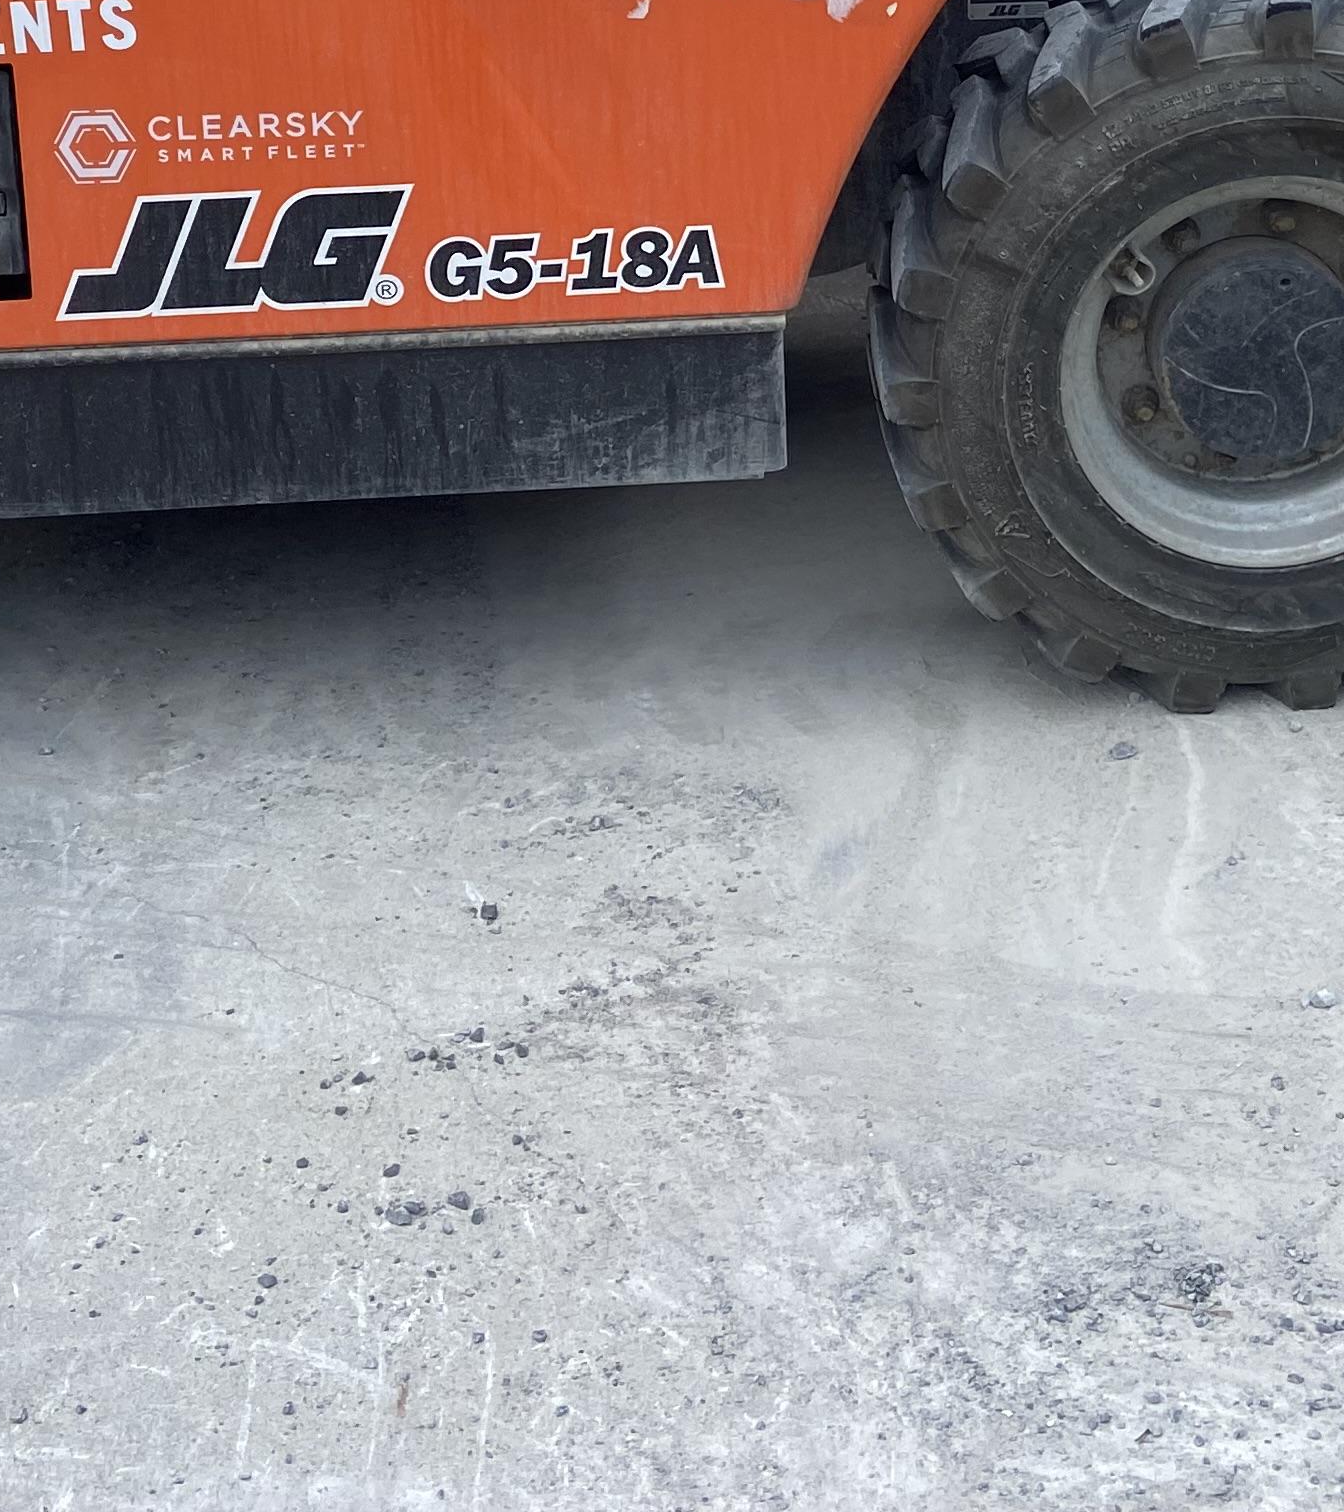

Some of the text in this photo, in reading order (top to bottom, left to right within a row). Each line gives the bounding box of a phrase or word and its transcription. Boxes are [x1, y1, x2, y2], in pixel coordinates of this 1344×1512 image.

[147, 110, 364, 142] CLEARSKY
[158, 143, 356, 164] SMART FLEET
[55, 183, 726, 322] JLG G5-18A
